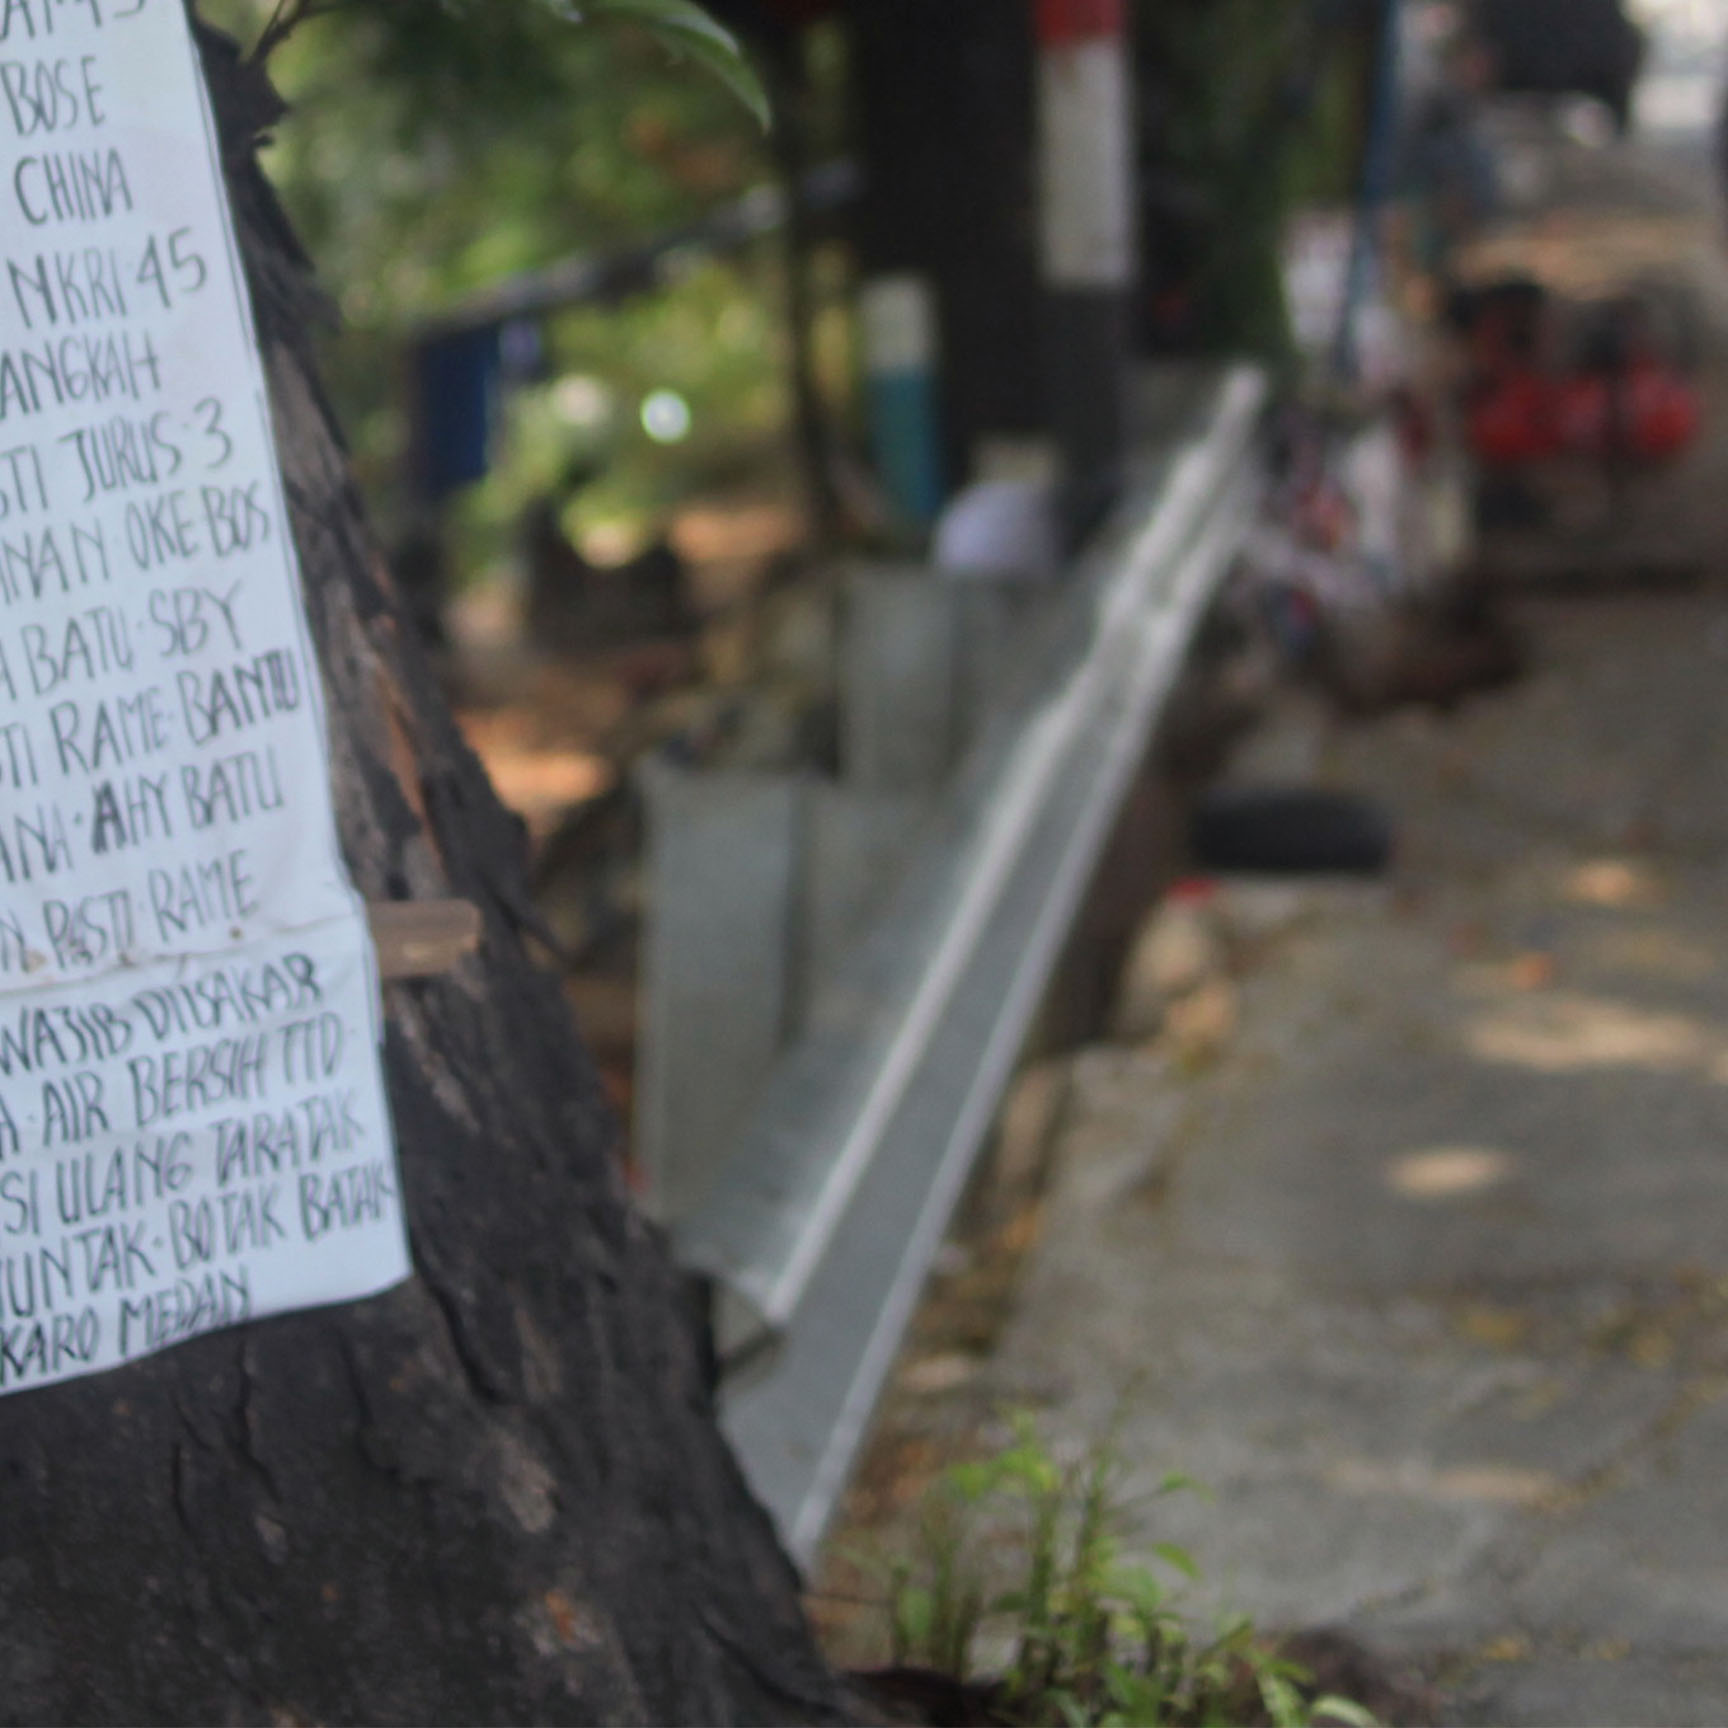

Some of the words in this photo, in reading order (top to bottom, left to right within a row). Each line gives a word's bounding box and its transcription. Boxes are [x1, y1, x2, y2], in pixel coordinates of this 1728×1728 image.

[0, 56, 106, 137] BOSE
[14, 148, 134, 226] CHINA
[6, 246, 128, 330] NKRI
[135, 226, 208, 310] 45
[56, 410, 184, 504] JURUS
[193, 396, 233, 471] 3
[125, 490, 200, 572] OKE
[201, 479, 270, 560] BOS
[20, 603, 134, 696] BATU
[148, 577, 243, 660] SBY
[48, 684, 170, 776] RAME
[90, 770, 174, 856] AHY
[179, 742, 284, 832] BATU
[147, 846, 260, 944] RAME
[42, 1068, 110, 1148] AIR
[126, 1032, 269, 1127] BERSIH
[56, 1130, 194, 1224] ULANG
[118, 1262, 252, 1358] MEDAN
